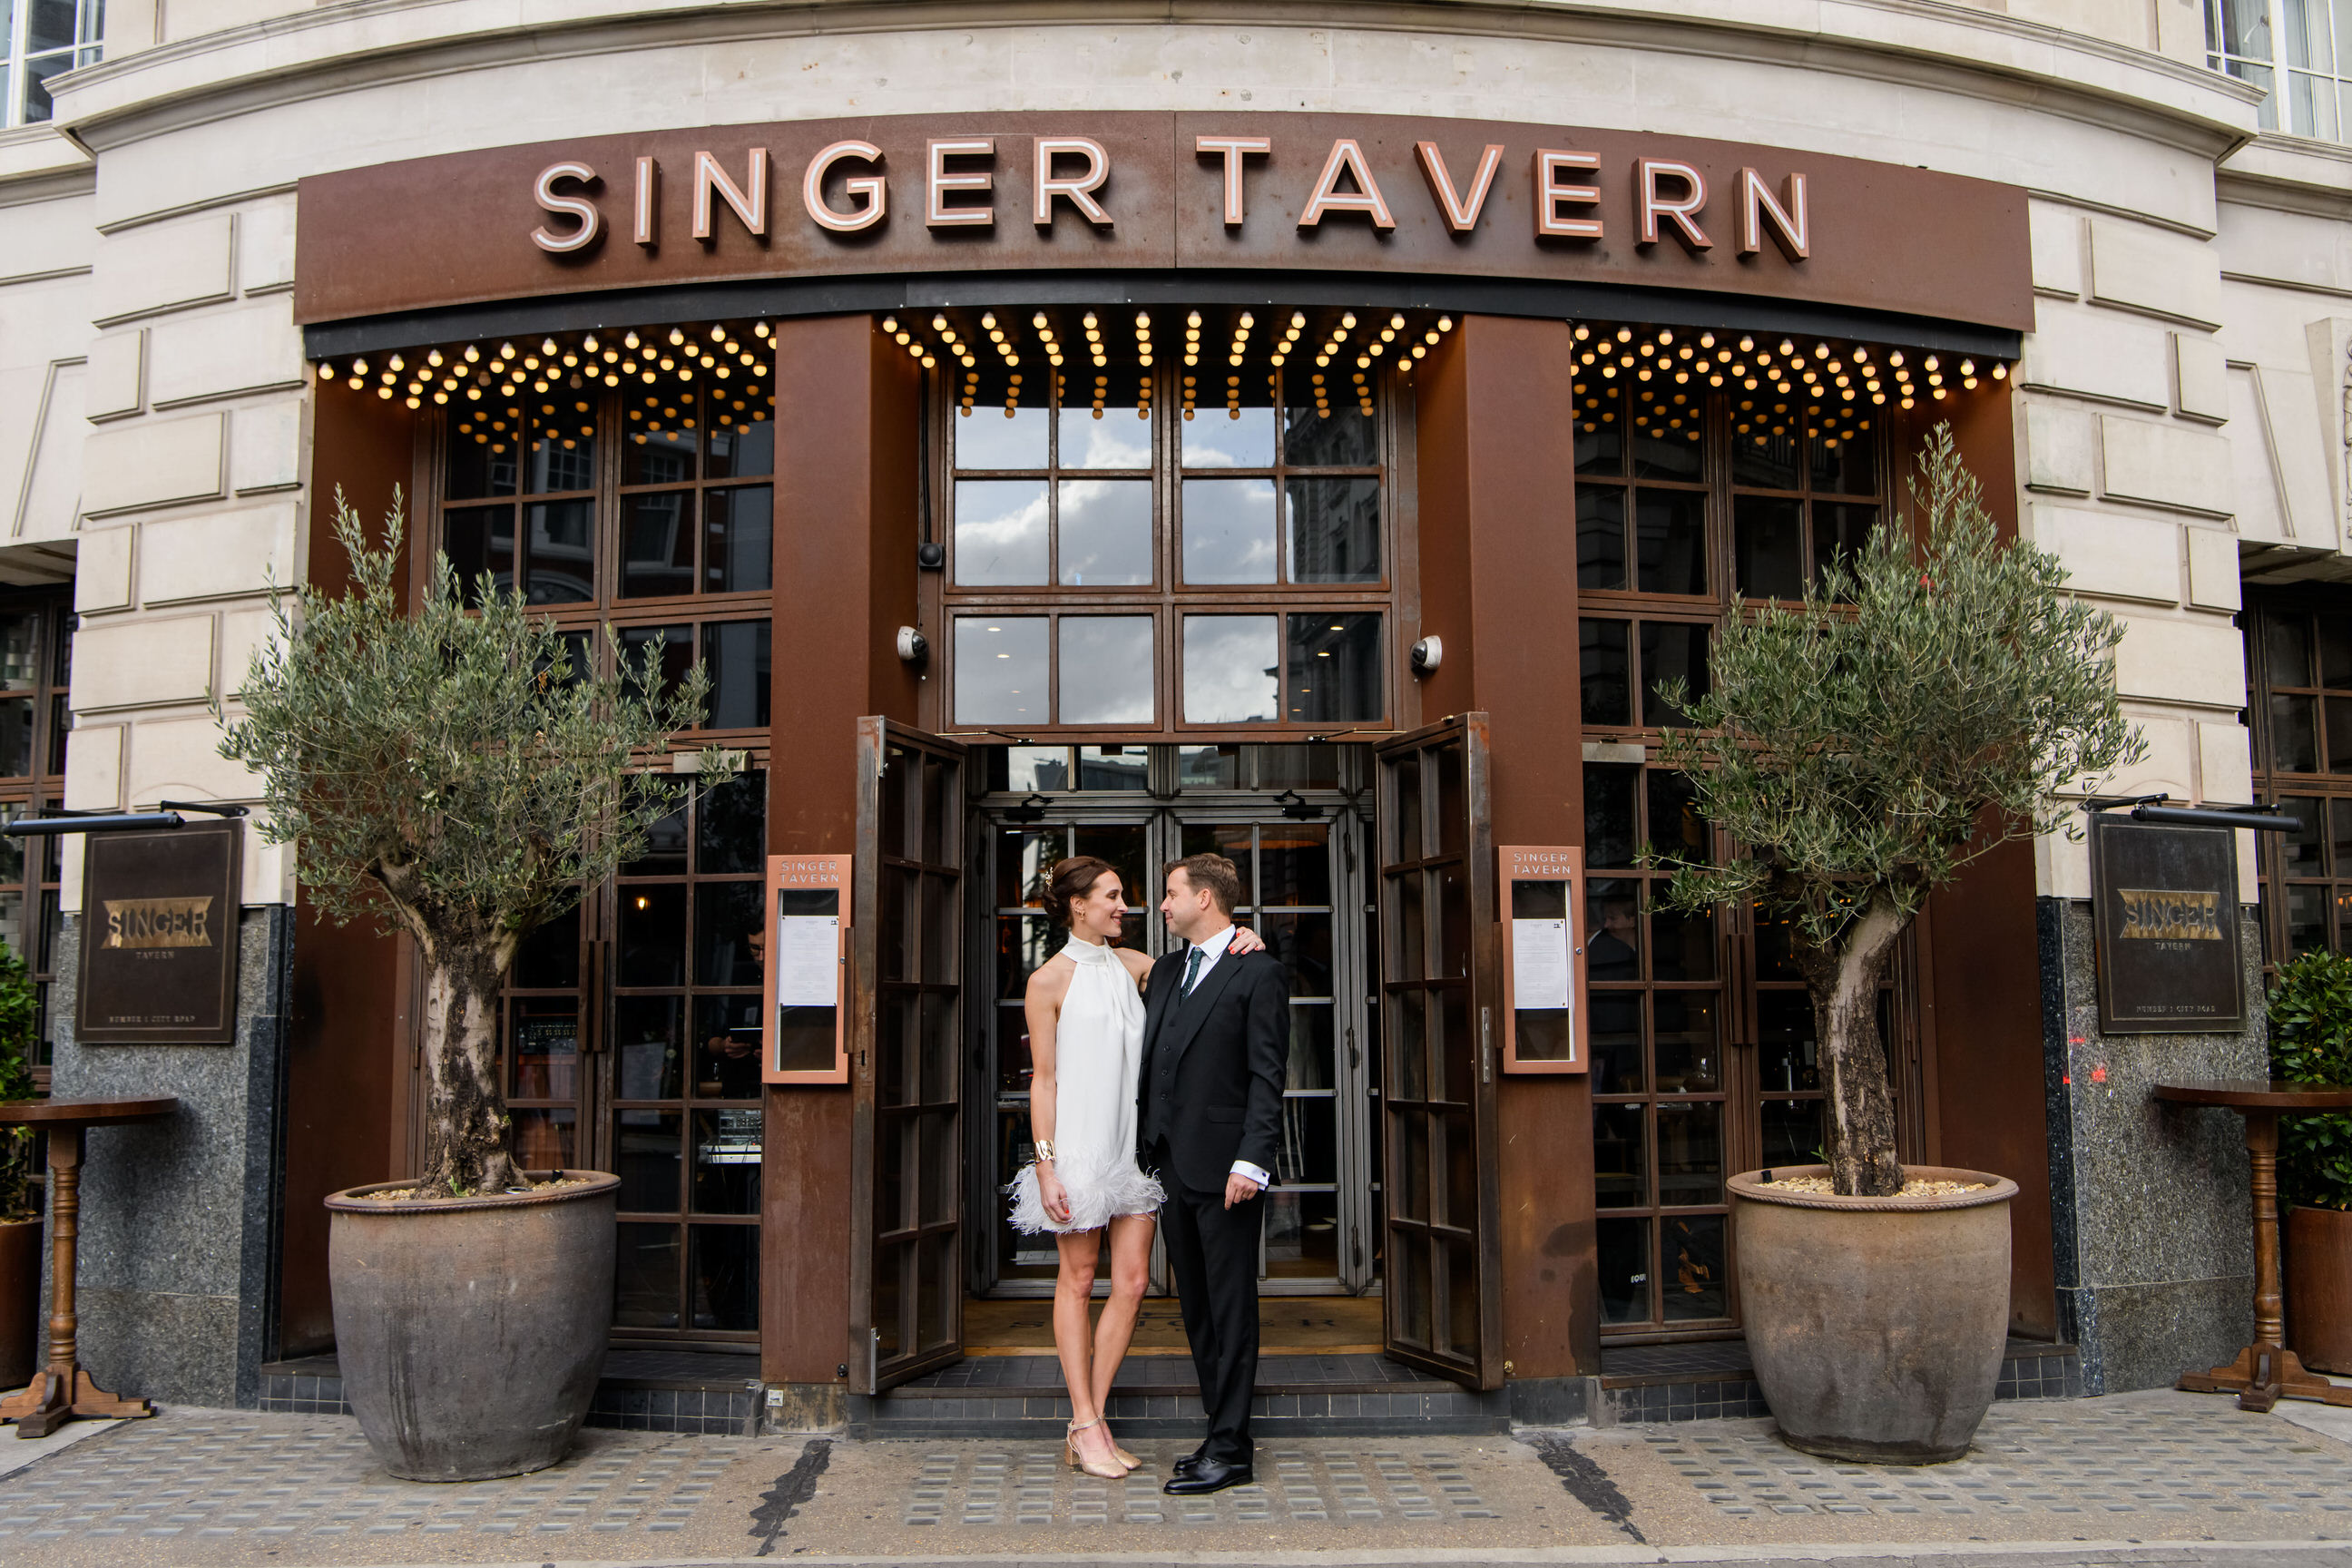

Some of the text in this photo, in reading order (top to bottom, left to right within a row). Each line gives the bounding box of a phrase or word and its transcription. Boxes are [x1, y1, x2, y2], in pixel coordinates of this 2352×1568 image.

[531, 136, 1808, 262] SINGER TAVERN
[1514, 852, 1568, 862] SINGER
[781, 861, 837, 871] SINGER
[1513, 864, 1571, 874] TAVERN
[779, 873, 839, 883] TAVERN
[2122, 895, 2219, 936] SINGER
[104, 903, 210, 945] SINGER
[2155, 942, 2191, 950] TAVERN
[135, 951, 174, 959] TAVERN
